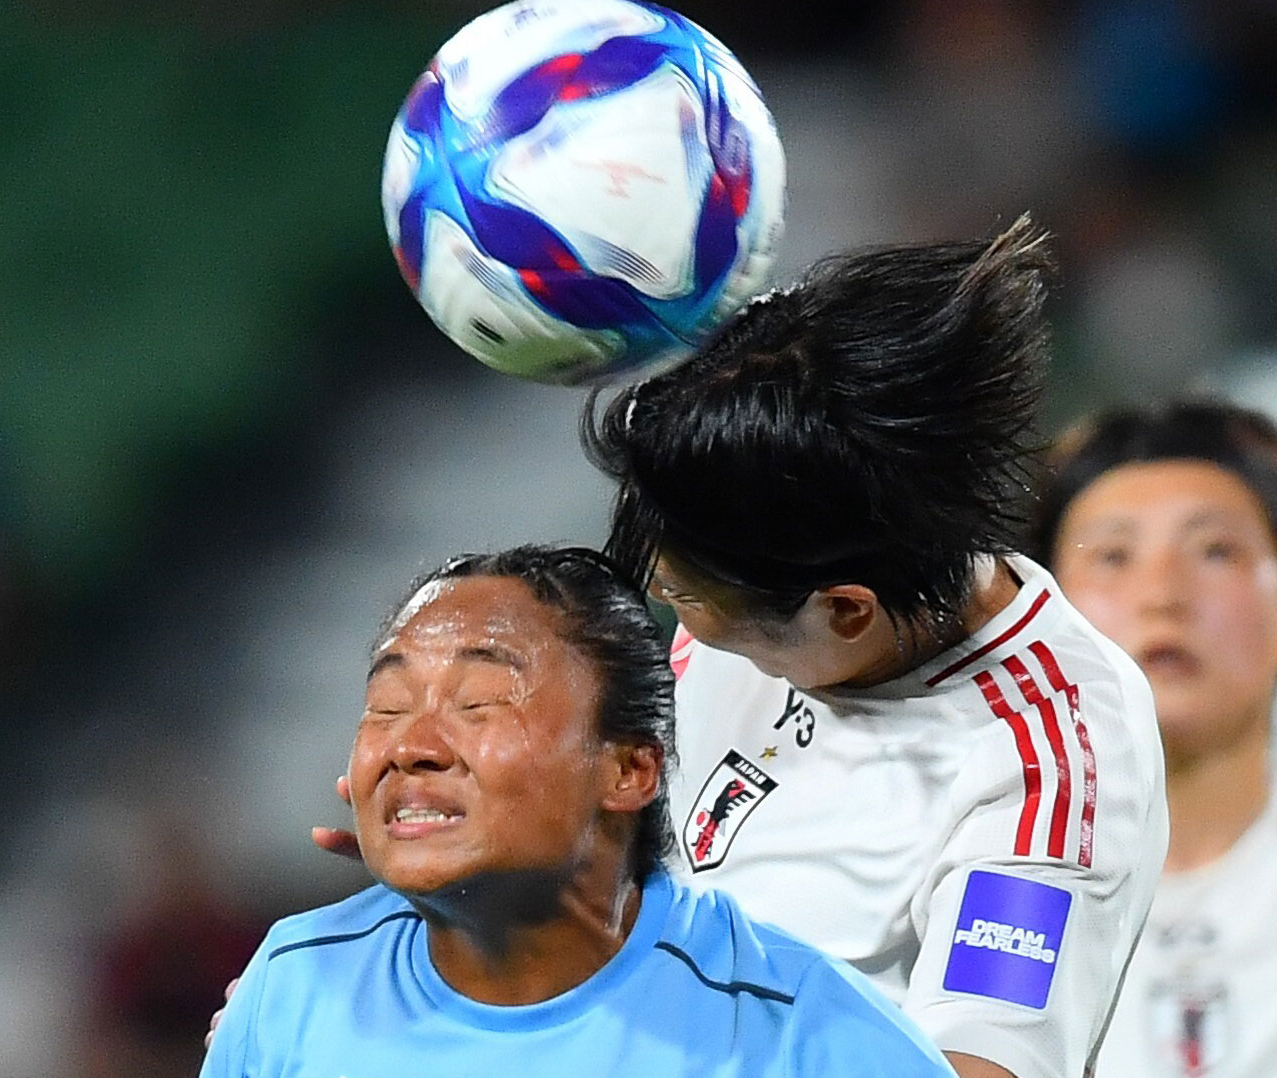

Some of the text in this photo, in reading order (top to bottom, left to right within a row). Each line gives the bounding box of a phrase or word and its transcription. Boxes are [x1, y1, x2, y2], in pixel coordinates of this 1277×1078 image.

[734, 759, 767, 785] JAPAN
[954, 929, 1056, 963] FEARLESS
[971, 919, 1046, 950] DREAM
